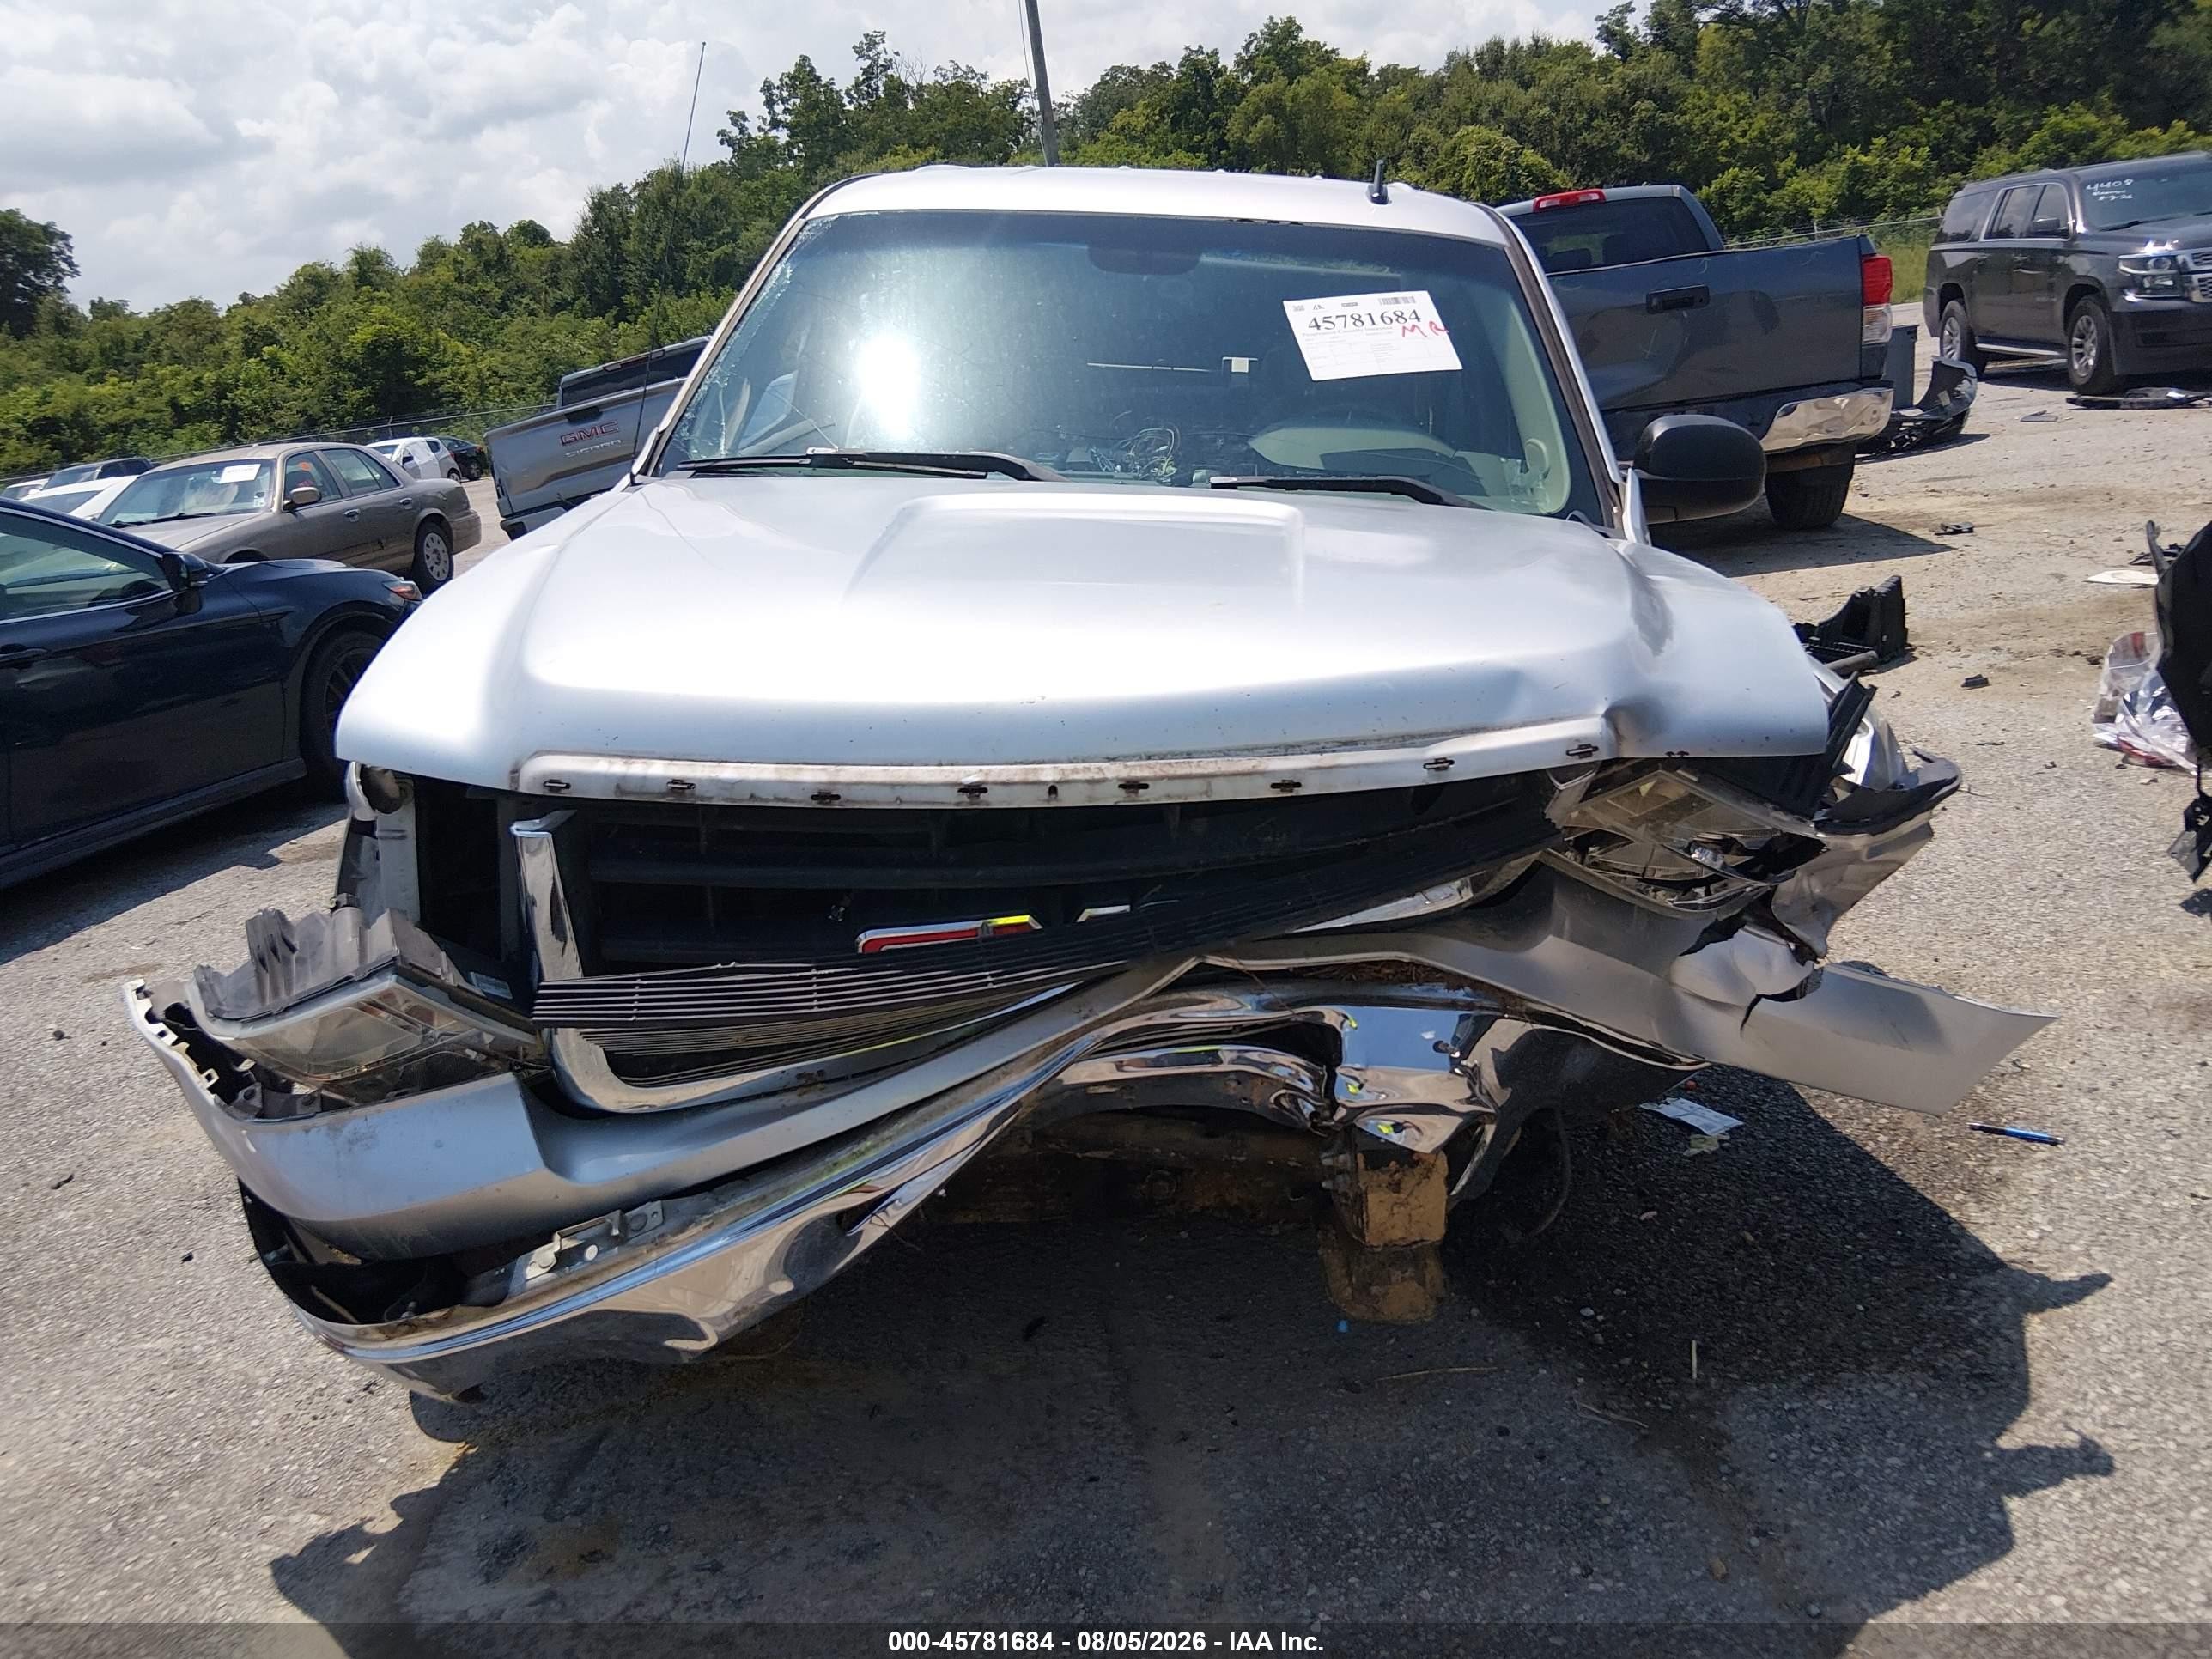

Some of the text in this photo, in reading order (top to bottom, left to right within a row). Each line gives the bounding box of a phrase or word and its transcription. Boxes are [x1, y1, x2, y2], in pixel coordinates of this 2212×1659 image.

[1308, 308, 1422, 331] 45781684
[560, 420, 619, 446] GMC
[564, 439, 622, 458] SIERRA
